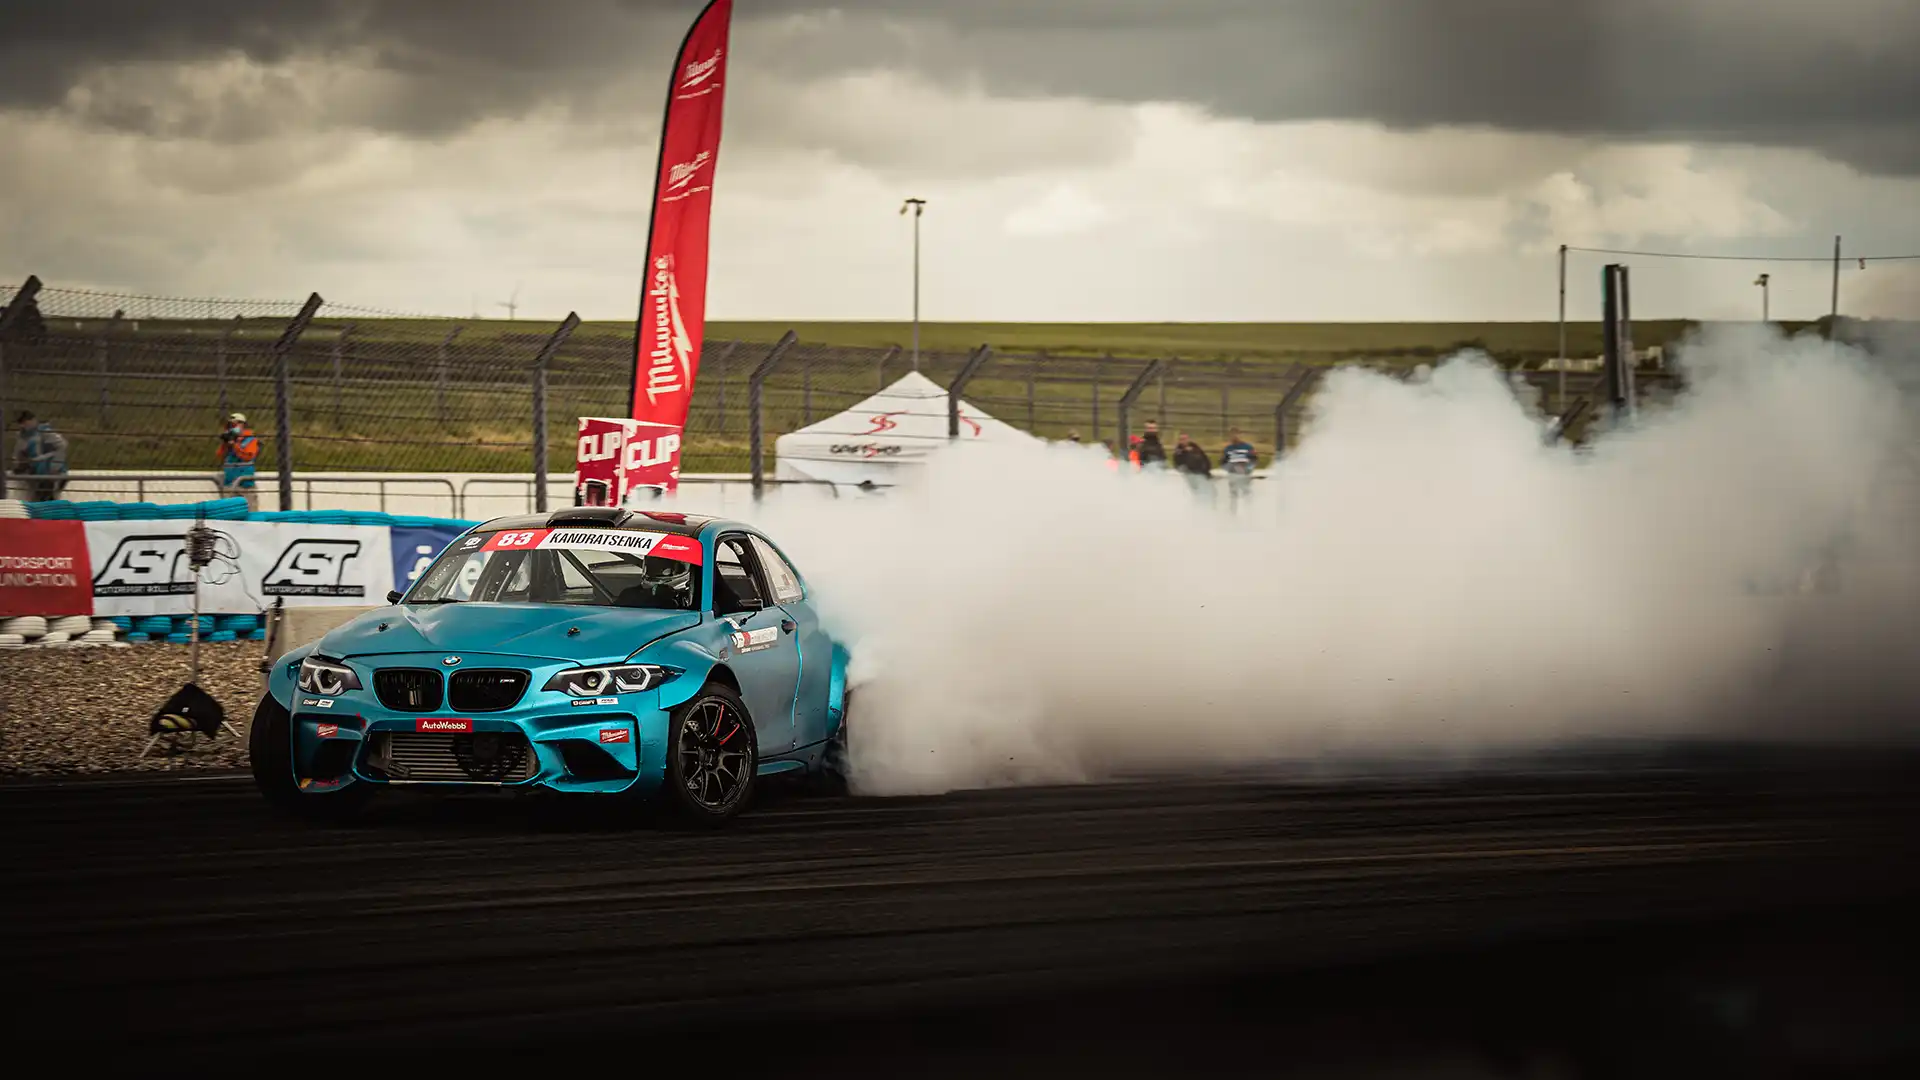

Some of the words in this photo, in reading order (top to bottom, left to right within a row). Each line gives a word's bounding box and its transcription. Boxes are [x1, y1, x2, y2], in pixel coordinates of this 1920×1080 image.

[646, 254, 683, 406] Milwaukee
[578, 431, 621, 463] CLIP
[626, 434, 680, 470] CLIP
[498, 532, 534, 546] 83
[550, 532, 653, 549] KANDRATSENKA
[422, 720, 467, 730] AutoWebbb
